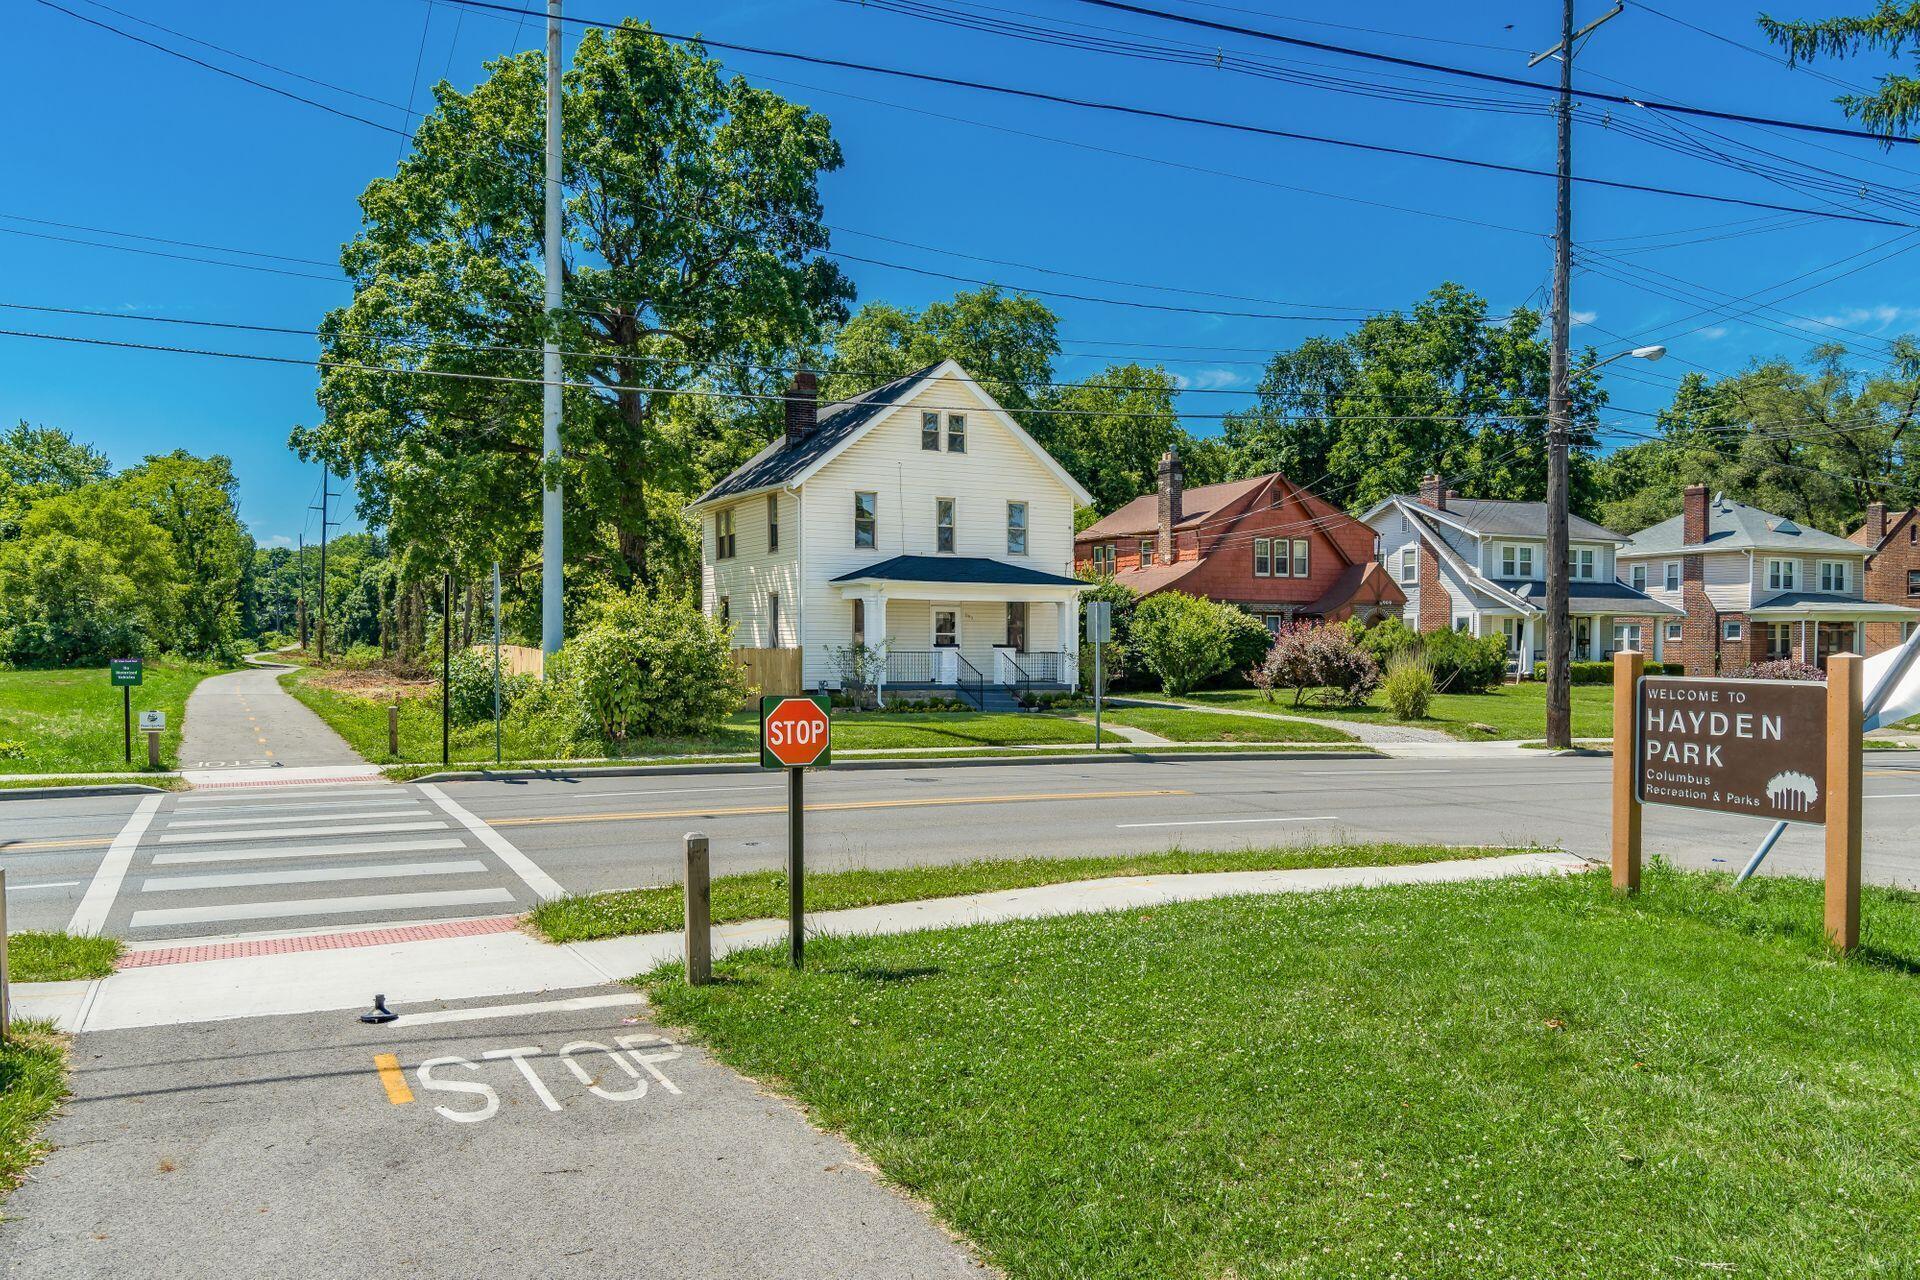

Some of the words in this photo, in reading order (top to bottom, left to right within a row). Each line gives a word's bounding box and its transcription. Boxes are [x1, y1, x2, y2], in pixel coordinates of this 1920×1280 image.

[1647, 688, 1719, 702] WELCOME
[1728, 691, 1746, 703] TO
[770, 720, 825, 746] STOP
[1647, 707, 1781, 741] HAYDEN
[1646, 739, 1723, 768] PARK
[1646, 768, 1711, 785] Columbus
[1646, 784, 1707, 800] Recreation
[1712, 791, 1720, 801] &
[1727, 793, 1760, 807] Parks
[416, 1033, 683, 1123] STOP
